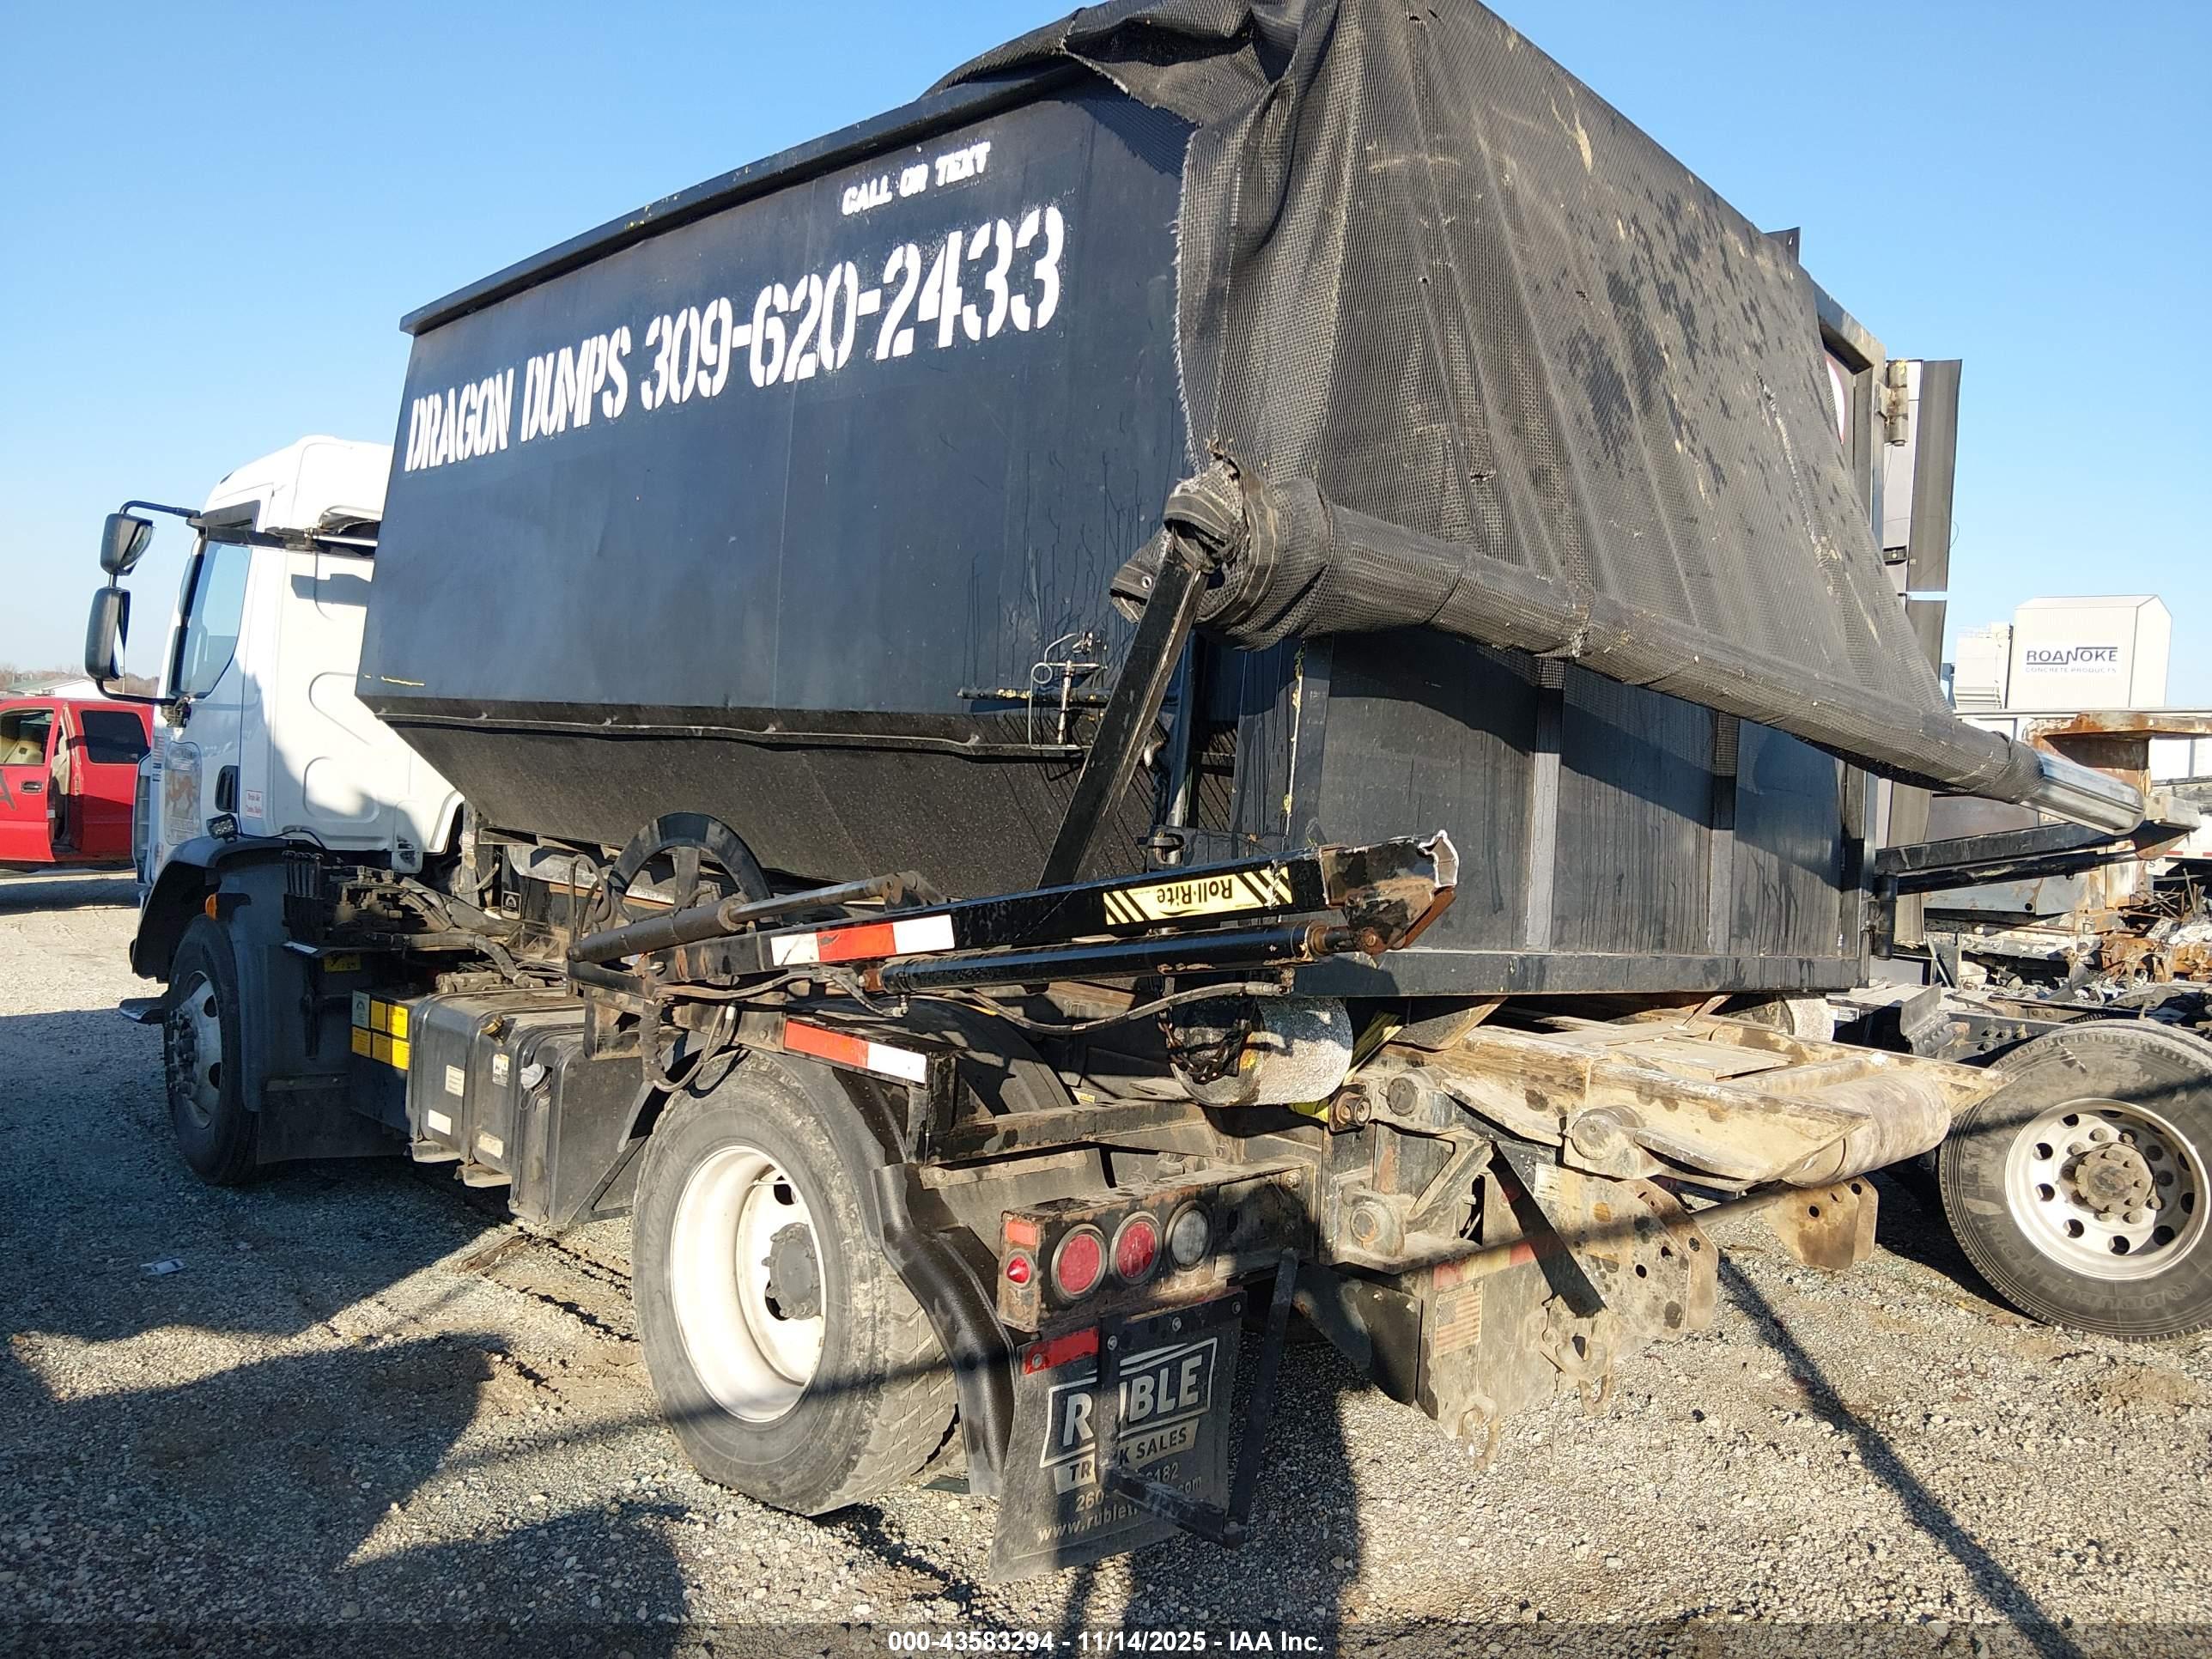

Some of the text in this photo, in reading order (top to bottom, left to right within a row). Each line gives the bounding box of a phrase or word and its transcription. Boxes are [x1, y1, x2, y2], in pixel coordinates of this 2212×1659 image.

[842, 141, 991, 216] CALL OR TEXT
[404, 203, 1065, 472] DRAGON DUMPS 309-620-2433
[2027, 647, 2118, 664] ROANOKE
[1135, 1426, 1188, 1460] SALES
